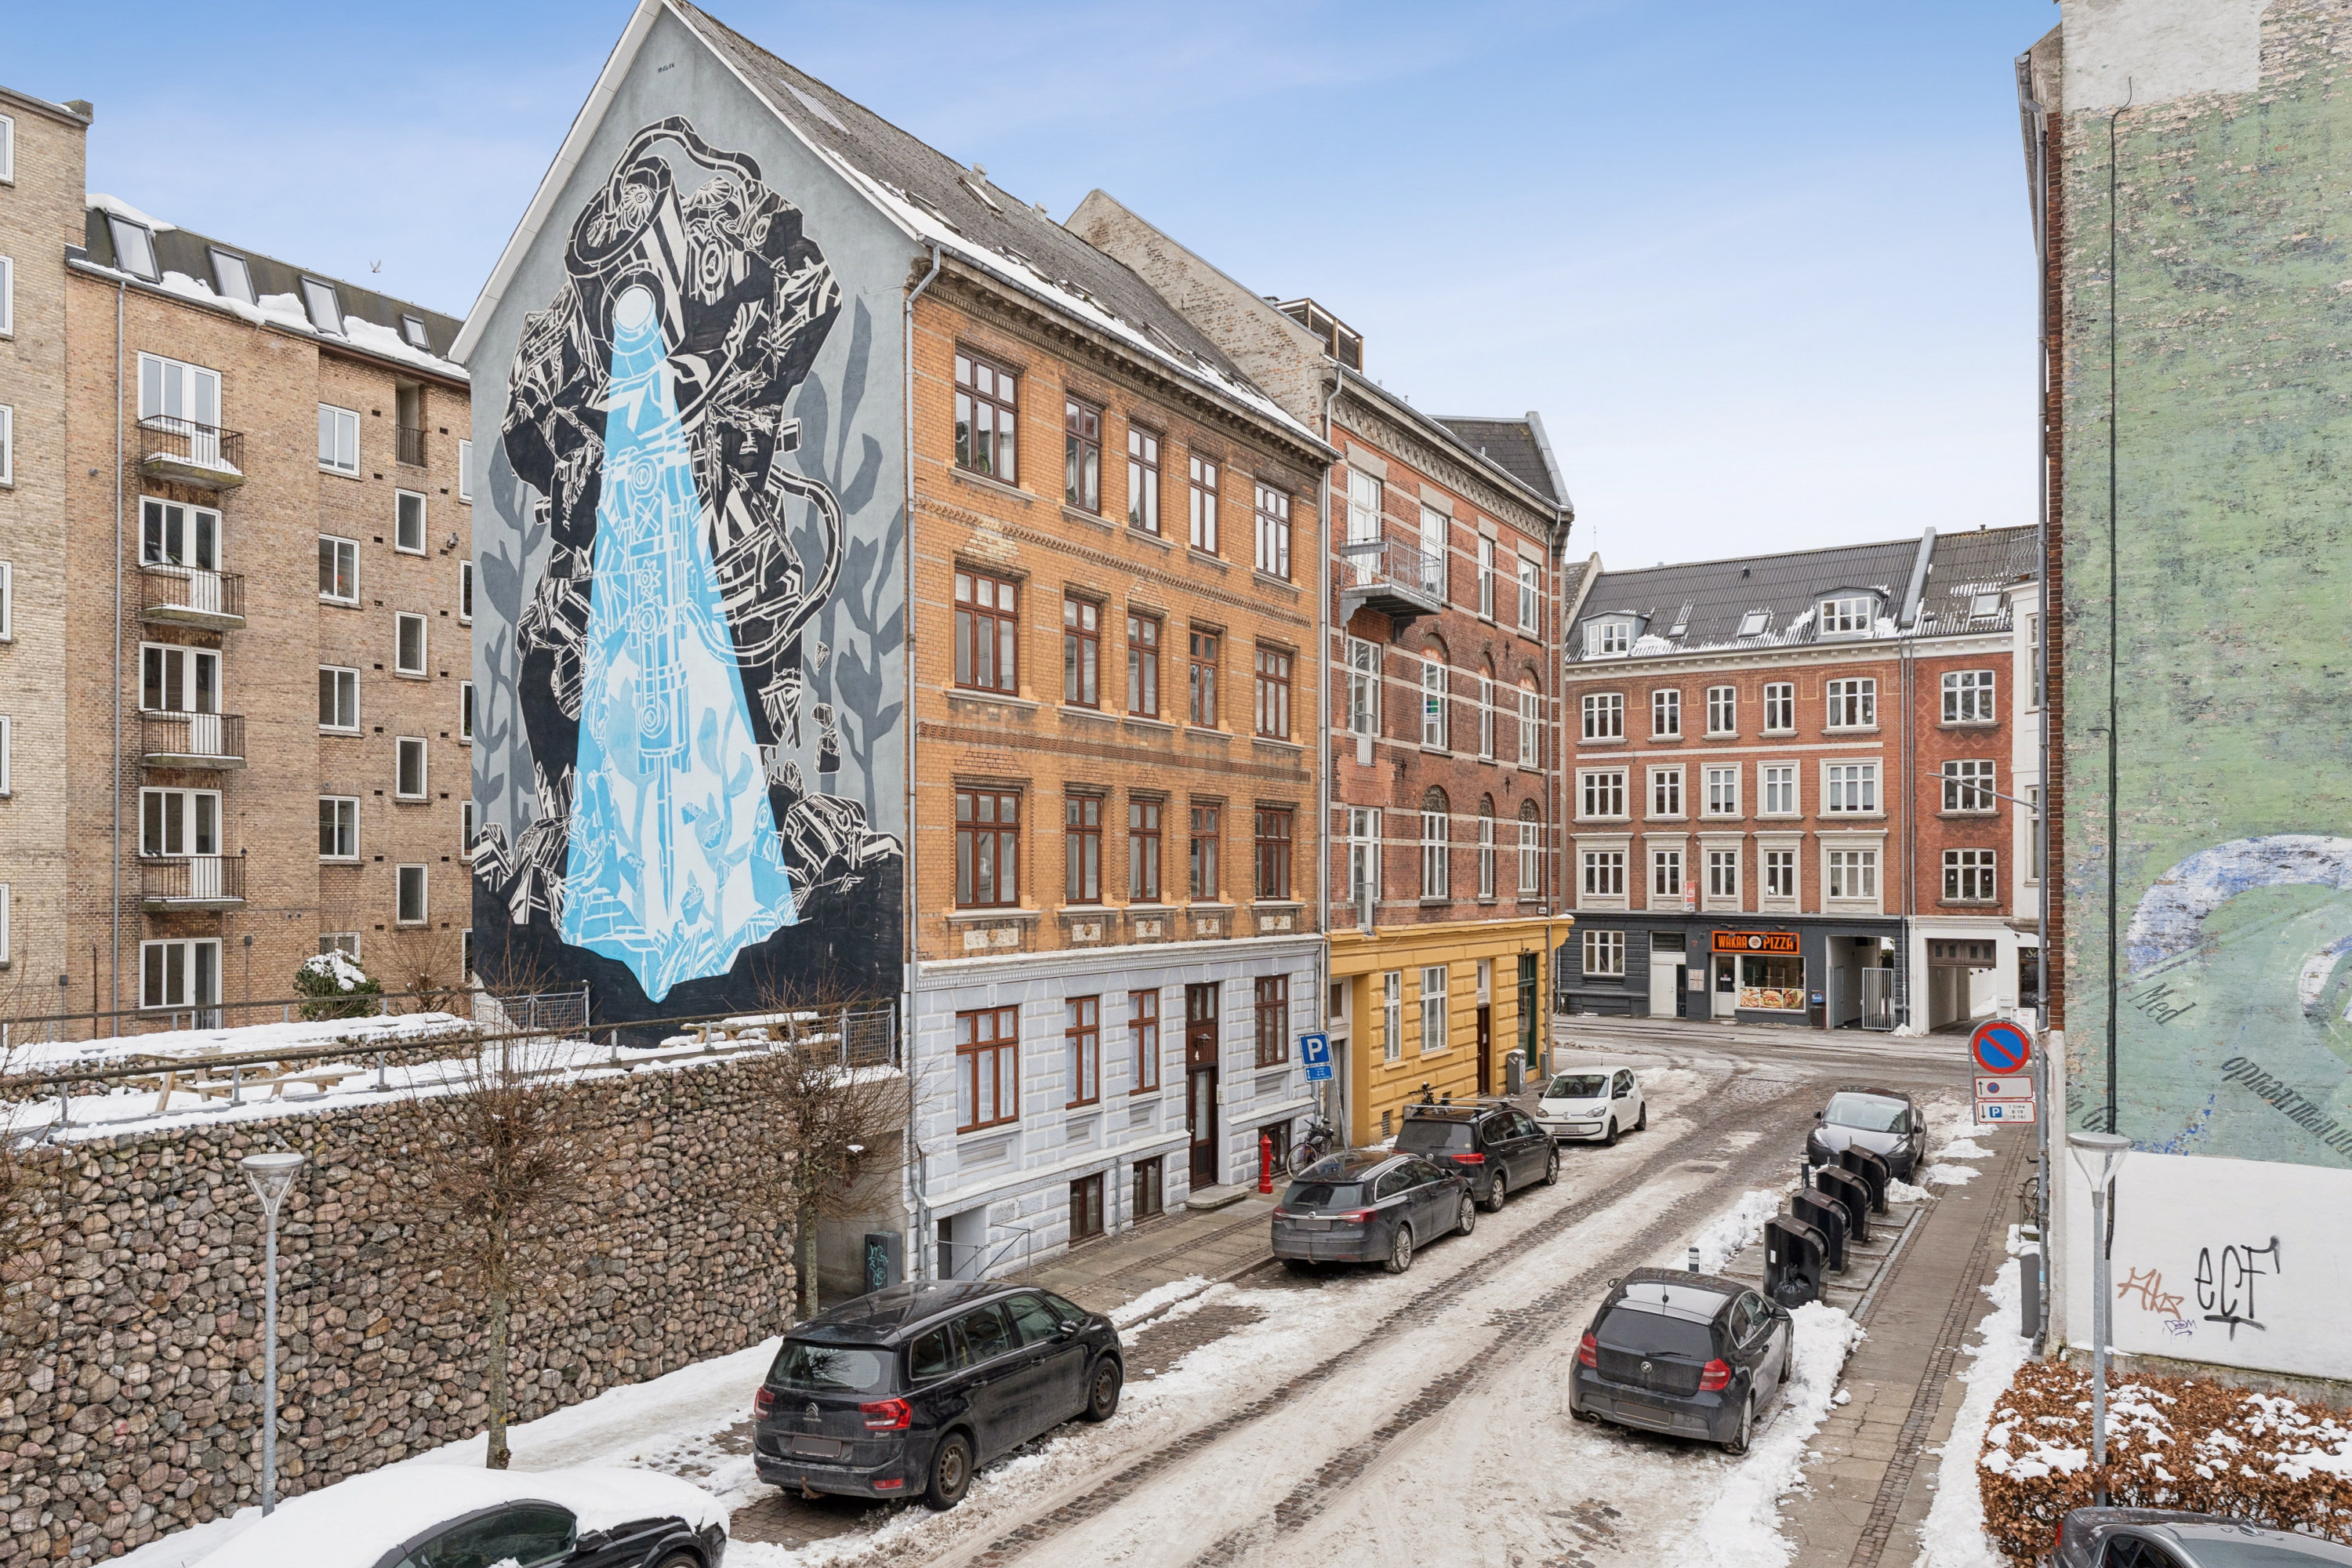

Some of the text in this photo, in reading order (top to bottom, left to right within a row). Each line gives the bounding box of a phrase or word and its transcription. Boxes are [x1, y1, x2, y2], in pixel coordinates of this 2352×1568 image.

[1718, 935, 1794, 949] WAKAA PIZZA
[1306, 1038, 1323, 1061] P
[1194, 1051, 1200, 1061] 4
[1992, 1108, 2000, 1116] P
